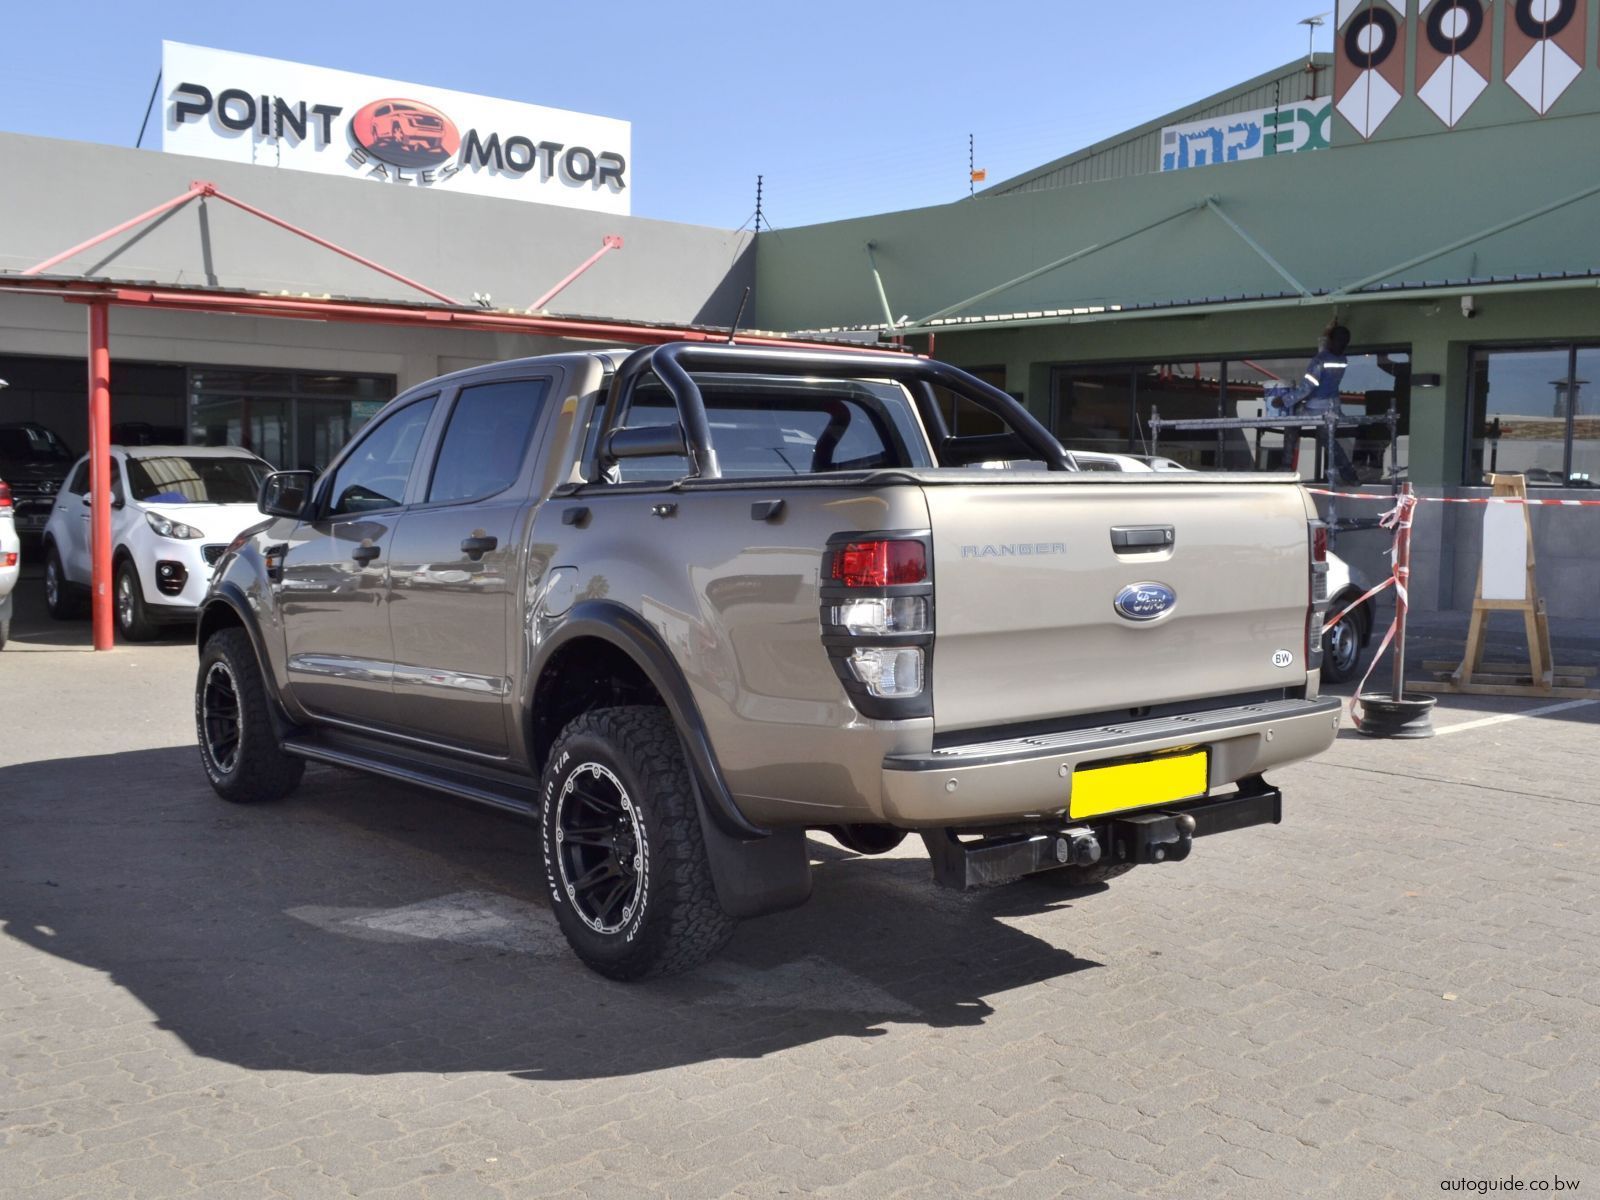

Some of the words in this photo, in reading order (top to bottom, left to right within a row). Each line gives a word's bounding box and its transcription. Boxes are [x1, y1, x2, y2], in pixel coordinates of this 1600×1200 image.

[176, 82, 343, 144] POINT
[463, 128, 626, 188] MOTOR
[351, 147, 460, 182] SALES
[961, 543, 1066, 557] RANGER
[1133, 590, 1166, 611] Ford
[1275, 653, 1290, 664] BW
[553, 751, 570, 774] T/A
